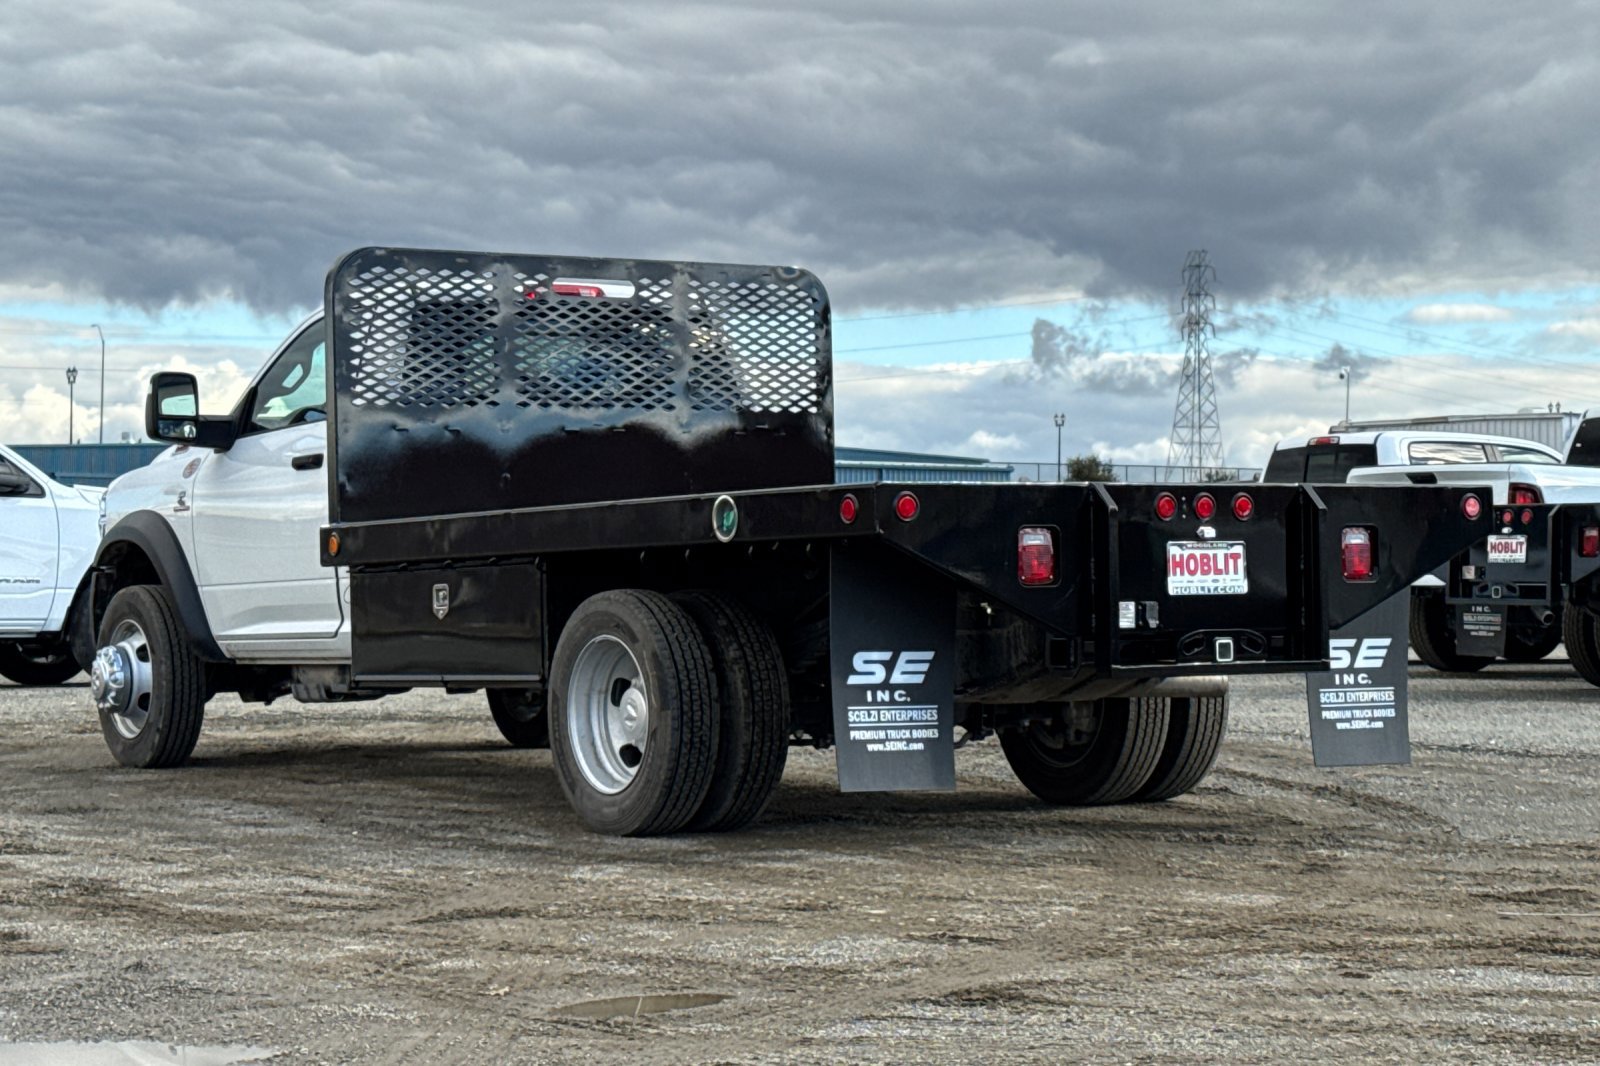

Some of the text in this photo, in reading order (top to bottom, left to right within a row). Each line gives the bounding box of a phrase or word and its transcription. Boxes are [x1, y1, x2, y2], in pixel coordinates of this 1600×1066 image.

[1490, 541, 1525, 554] HOBLIT
[1171, 553, 1242, 576] HOBLIT
[1172, 586, 1245, 595] HOBLIT.COM
[1329, 638, 1393, 669] SE
[846, 651, 936, 685] SE
[1334, 673, 1373, 685] INC.
[866, 690, 911, 702] INC.
[1320, 691, 1395, 703] SCELZI ENTERPRISES
[848, 709, 938, 722] SCELZI ENTERPRISES
[1321, 708, 1395, 719] PREMIUM TRUCK BODIES
[850, 728, 939, 740] PREMIUM TRUCK BODIES
[866, 741, 924, 751] www.SEINC.com
